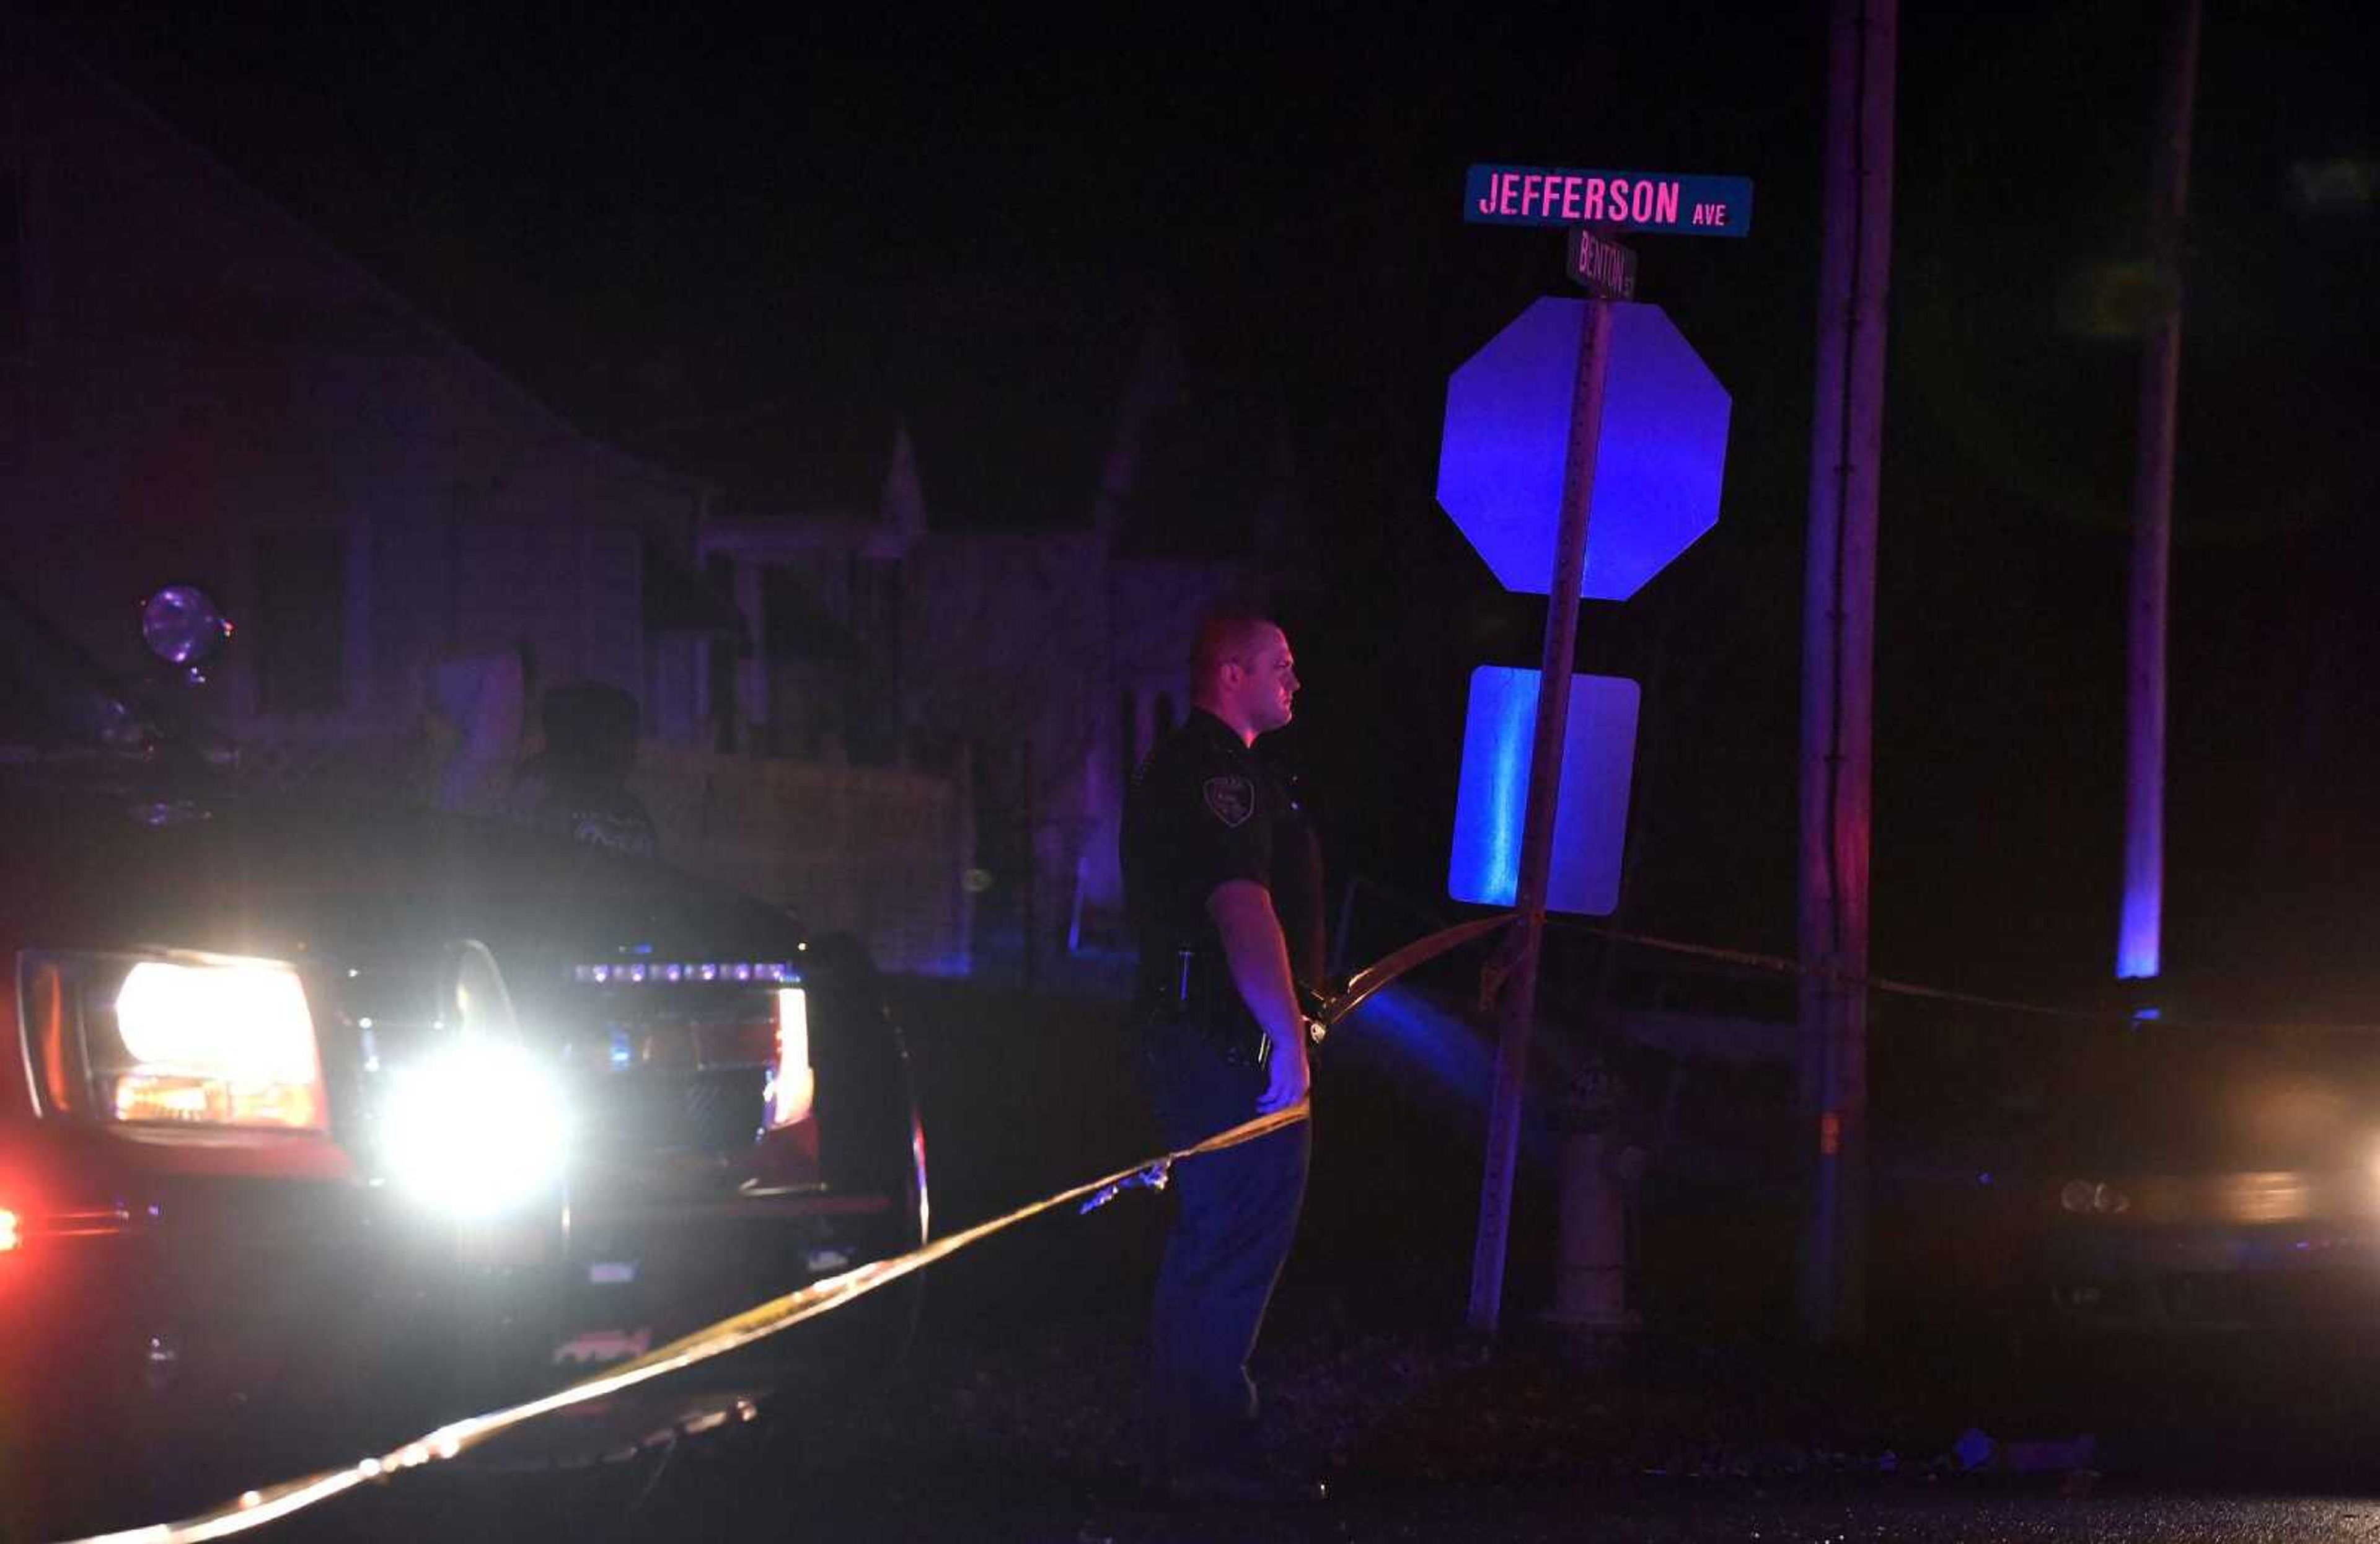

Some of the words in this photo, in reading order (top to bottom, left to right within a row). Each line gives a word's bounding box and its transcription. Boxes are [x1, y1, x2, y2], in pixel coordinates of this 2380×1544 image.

[1479, 173, 1681, 224] JEFFERSON
[1693, 204, 1726, 226] AVE
[1579, 229, 1625, 294] BENTON
